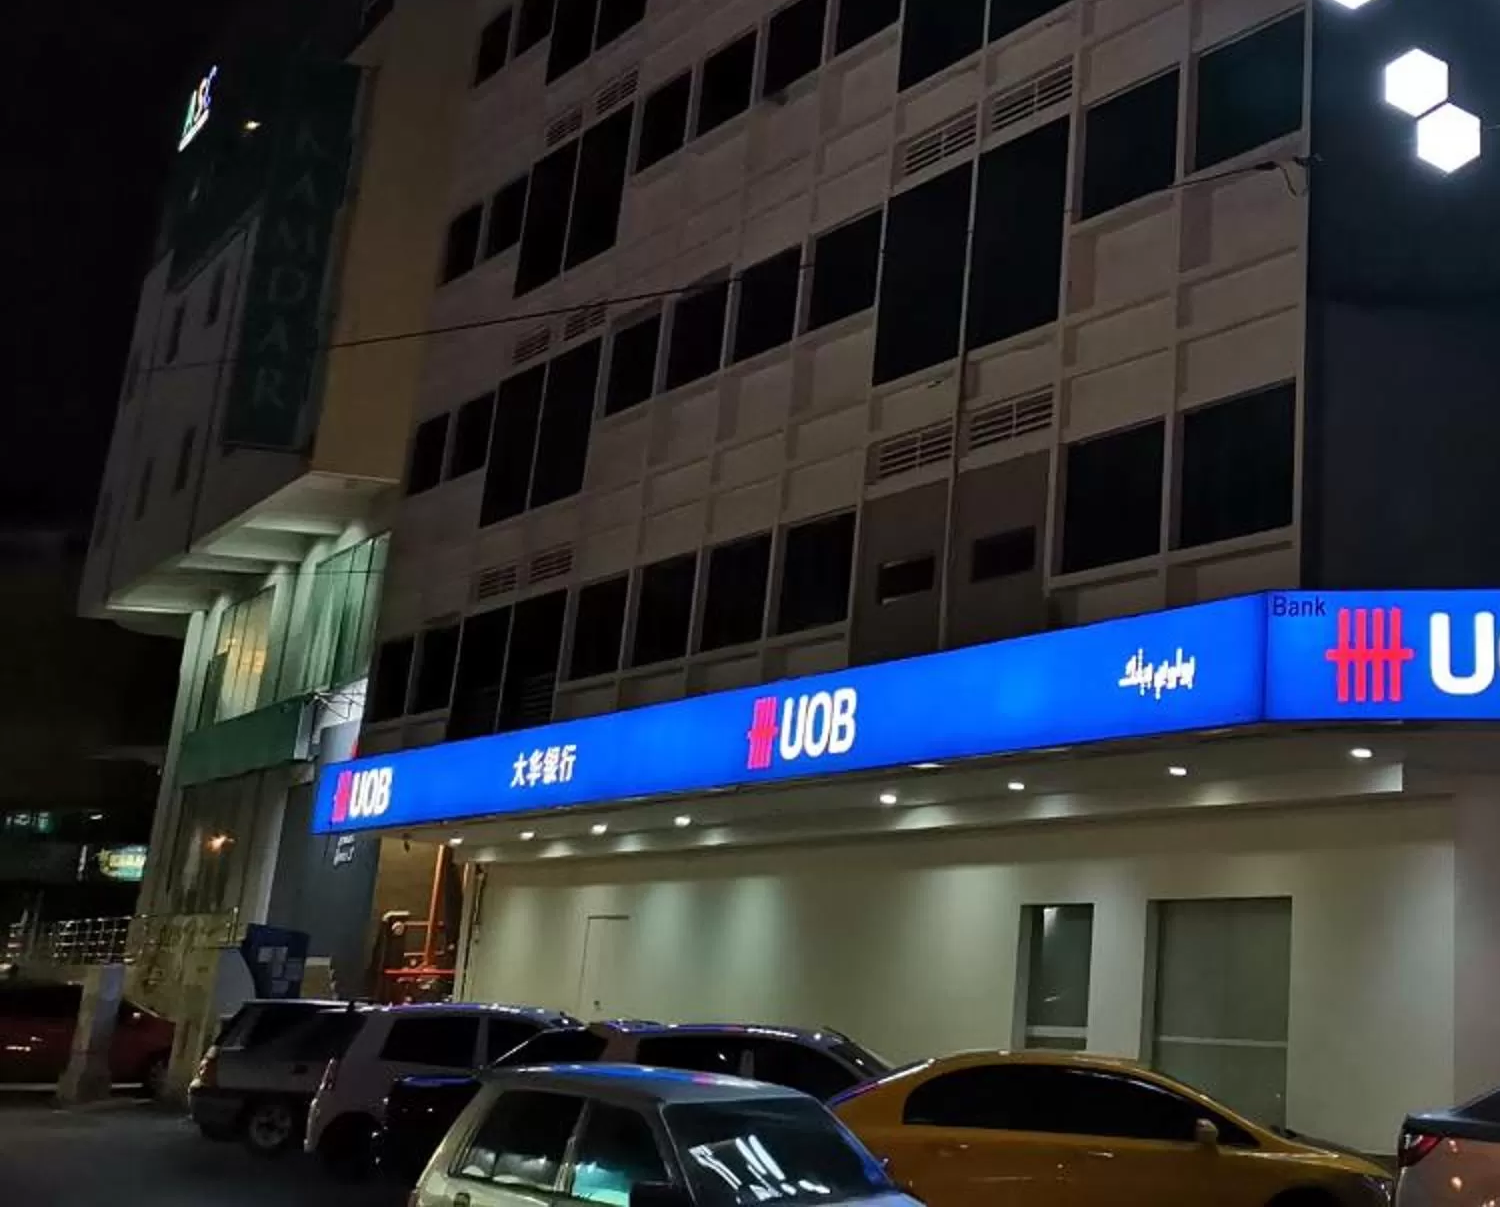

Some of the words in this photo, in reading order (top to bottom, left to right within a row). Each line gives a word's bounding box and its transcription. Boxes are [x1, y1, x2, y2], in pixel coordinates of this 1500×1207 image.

[1272, 595, 1327, 617] Bank
[779, 688, 857, 760] UOB
[510, 744, 577, 788] 大华银行
[349, 766, 393, 818] UOB
